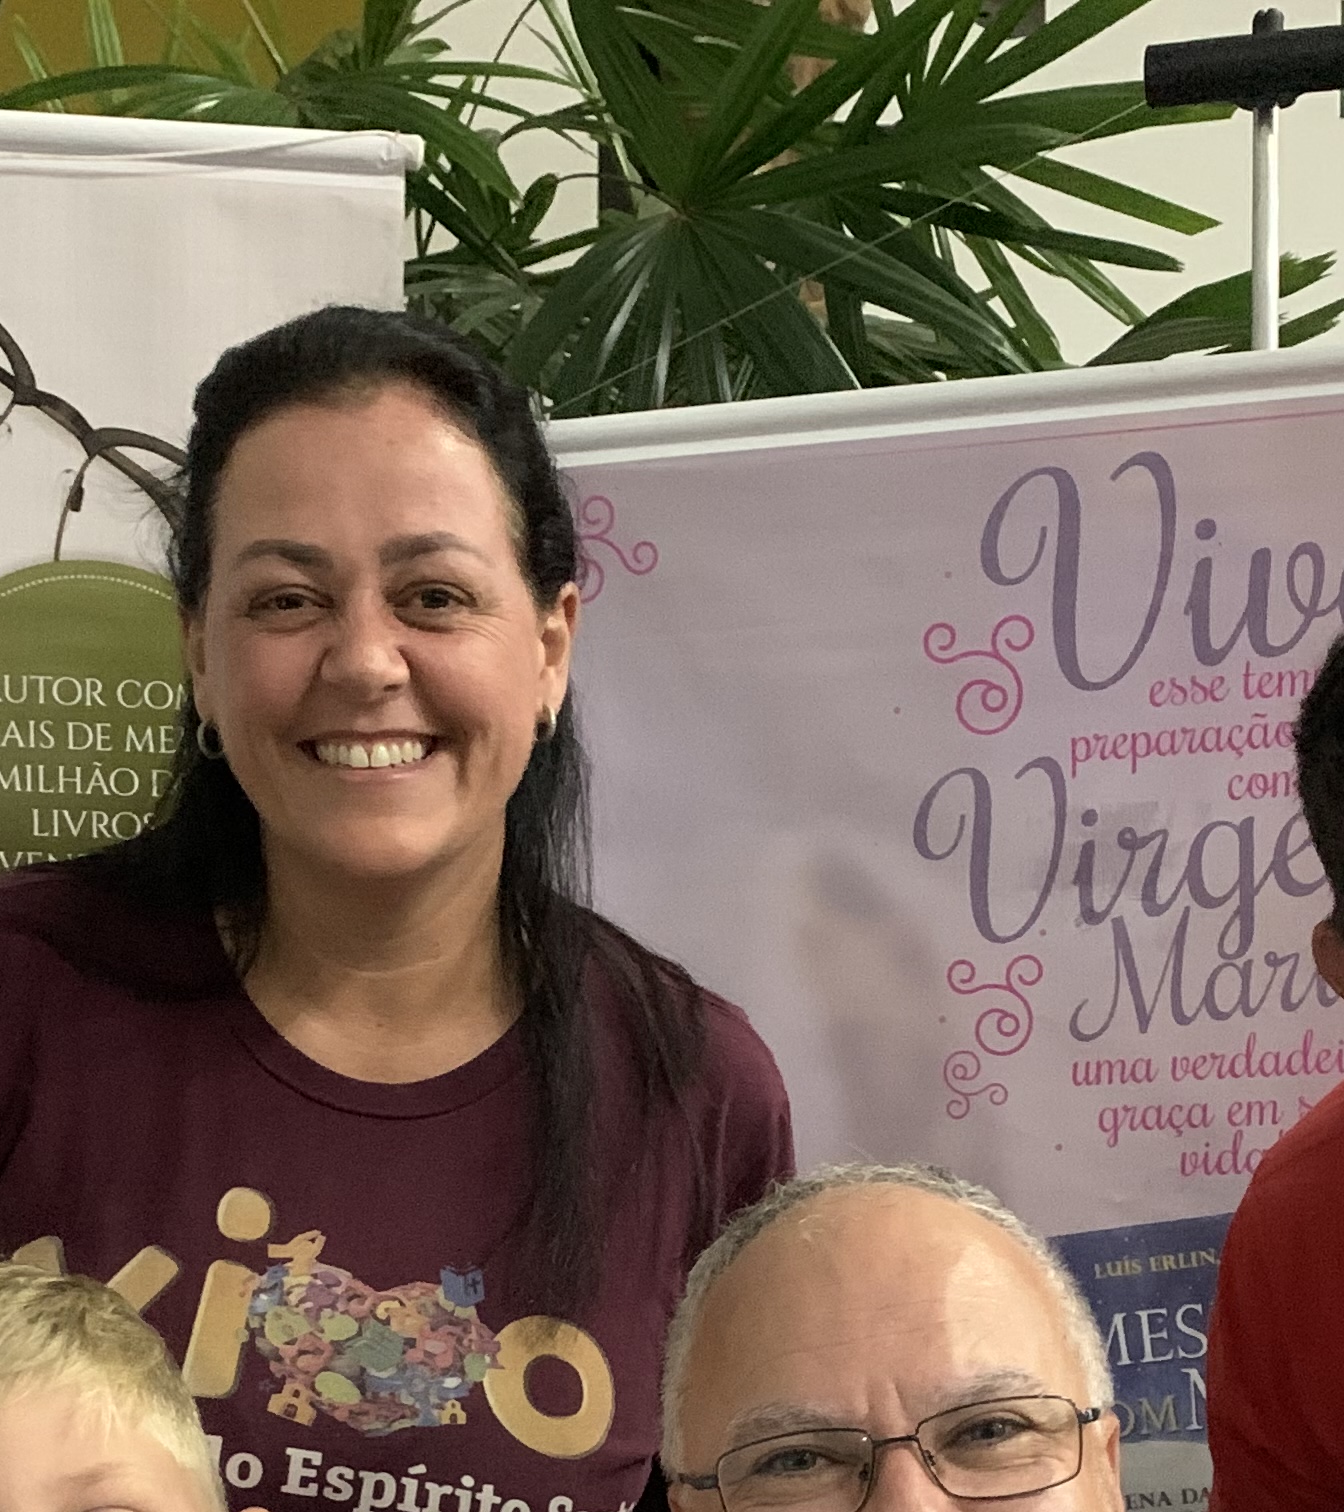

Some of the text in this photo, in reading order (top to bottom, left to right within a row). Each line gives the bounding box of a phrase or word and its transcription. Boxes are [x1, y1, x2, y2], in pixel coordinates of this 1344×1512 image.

[1149, 659, 1321, 709] esse tem
[67, 721, 113, 752] DE
[1070, 712, 1297, 780] preparação
[1071, 1055, 1159, 1087] uma
[1097, 1100, 1215, 1149] graça
[1227, 1098, 1284, 1128] em
